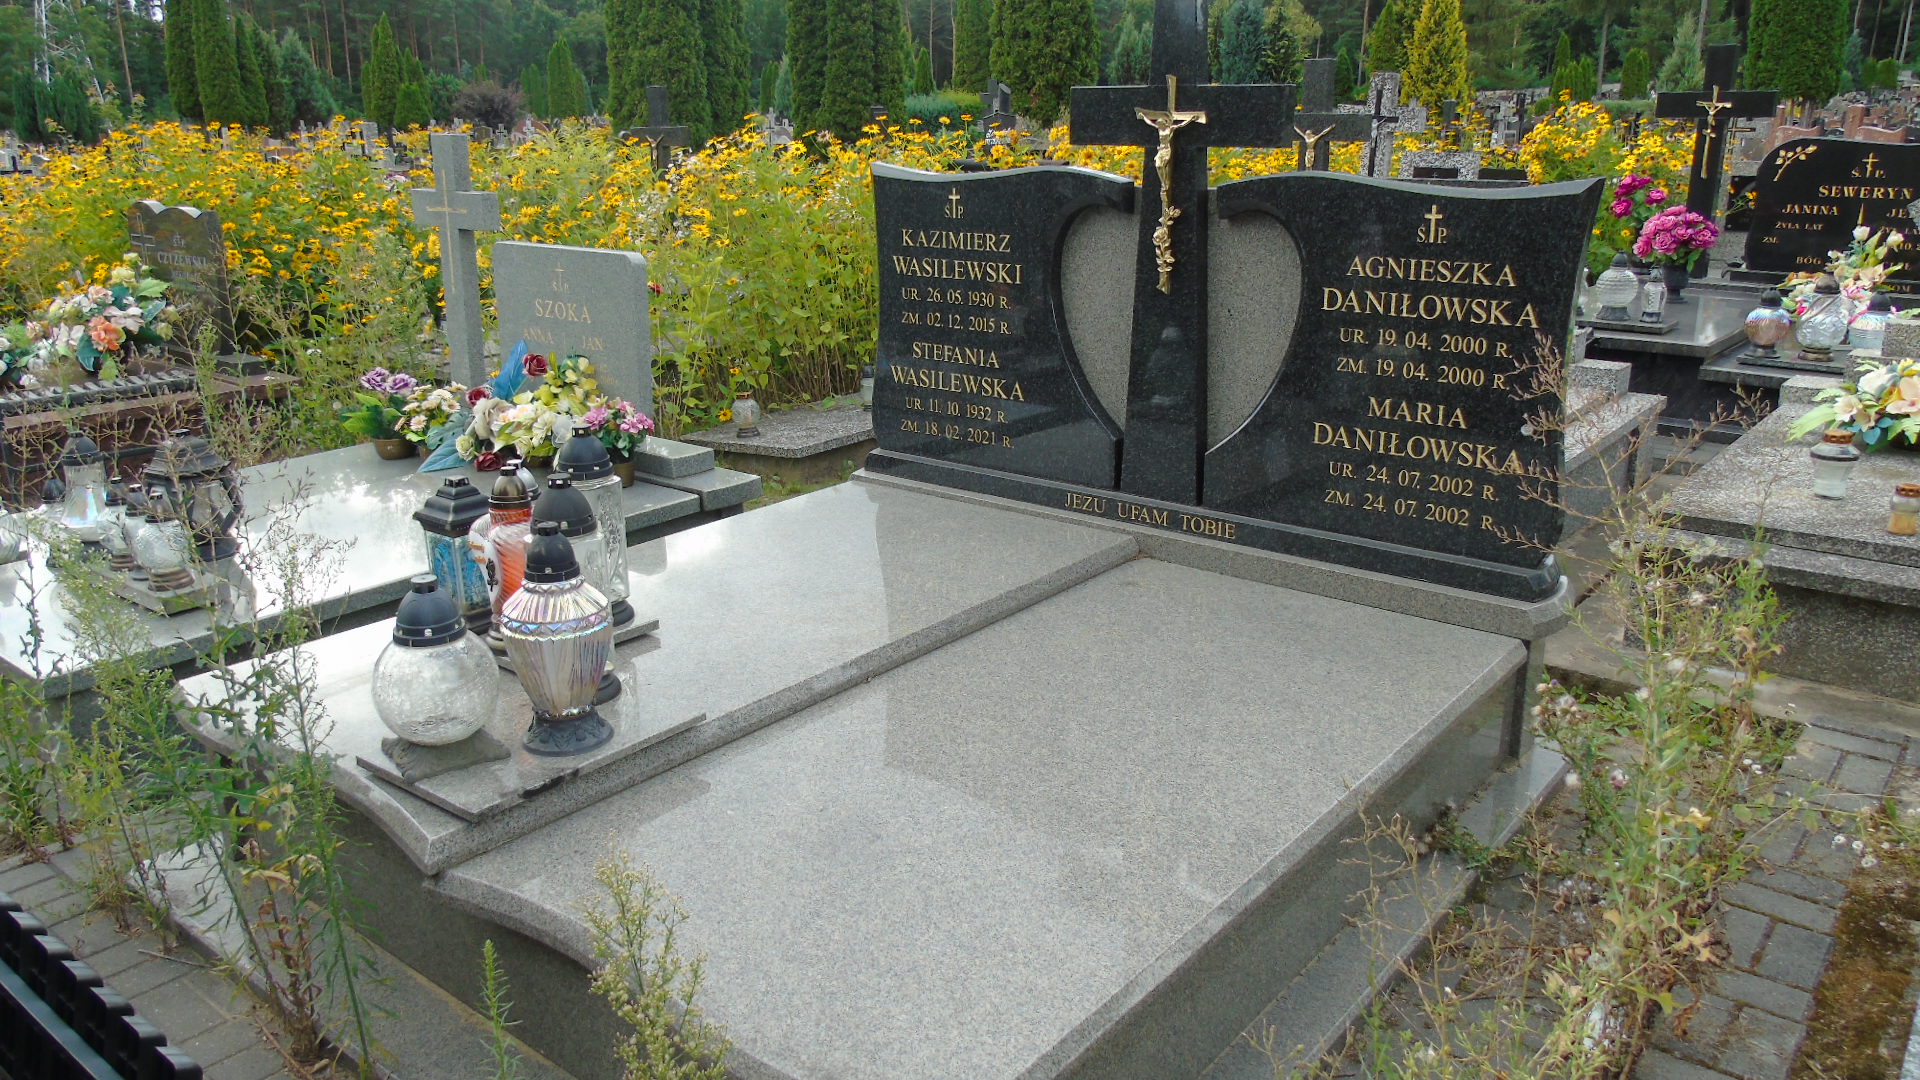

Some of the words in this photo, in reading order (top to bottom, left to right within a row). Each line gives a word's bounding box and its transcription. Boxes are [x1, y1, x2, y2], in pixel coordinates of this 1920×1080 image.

[1818, 185, 1913, 200] SEWERYN
[1782, 203, 1839, 216] JANINA
[901, 228, 1011, 253] KAZIMIERZ
[892, 255, 1023, 285] WASILEWSKI
[1346, 255, 1517, 287] AGNIESZKA
[1796, 255, 1822, 265] BÓG
[535, 298, 592, 324] SZOKA
[902, 287, 922, 301] UR.
[926, 287, 943, 303] 26.
[947, 290, 964, 305] 05.
[967, 291, 995, 308] 1930
[999, 296, 1011, 309] R.
[1320, 287, 1540, 328] DANIŁOWSKA
[902, 311, 922, 325] ZM.
[926, 312, 944, 327] 02.
[948, 314, 964, 329] 12.
[968, 316, 996, 333] 2015
[999, 321, 1012, 335] R.
[523, 328, 554, 344] ANNA
[582, 335, 604, 351] JAN
[1339, 327, 1369, 344] UR.
[1377, 328, 1397, 347] 19.
[1405, 331, 1431, 350] 04.
[1439, 334, 1487, 355] 2000
[1495, 342, 1513, 358] R.
[912, 341, 1000, 369] STEFANIA
[890, 364, 1025, 401] WASILEWSKA
[1336, 357, 1367, 374] ZM.
[1375, 358, 1395, 377] 19.
[1402, 361, 1429, 381] 04.
[1437, 364, 1485, 387] 2000
[1492, 373, 1510, 390] R.
[905, 396, 925, 411] UR.
[929, 399, 942, 414] 11.
[947, 401, 961, 417] 10.
[966, 404, 992, 420] 1932
[997, 410, 1009, 424] R.
[1367, 395, 1468, 429] MARIA
[900, 419, 921, 433] ZM.
[924, 420, 941, 437] 18.
[945, 424, 963, 440] 02.
[967, 427, 995, 445] 2021
[1002, 435, 1015, 448] R.
[1312, 421, 1524, 475] DANIŁOWSKA
[1328, 461, 1357, 479] UR.
[1366, 464, 1391, 484] 24.
[1398, 469, 1420, 489] 07.
[1428, 474, 1474, 497] 2002
[1481, 484, 1499, 501] R.
[1064, 492, 1107, 513] JEZU
[1117, 502, 1169, 527] UFAM
[1180, 514, 1236, 540] TOBIE
[1324, 489, 1354, 507] ZM.
[1362, 493, 1387, 513] 24.
[1394, 498, 1417, 518] 07.
[1424, 503, 1470, 527] 2002
